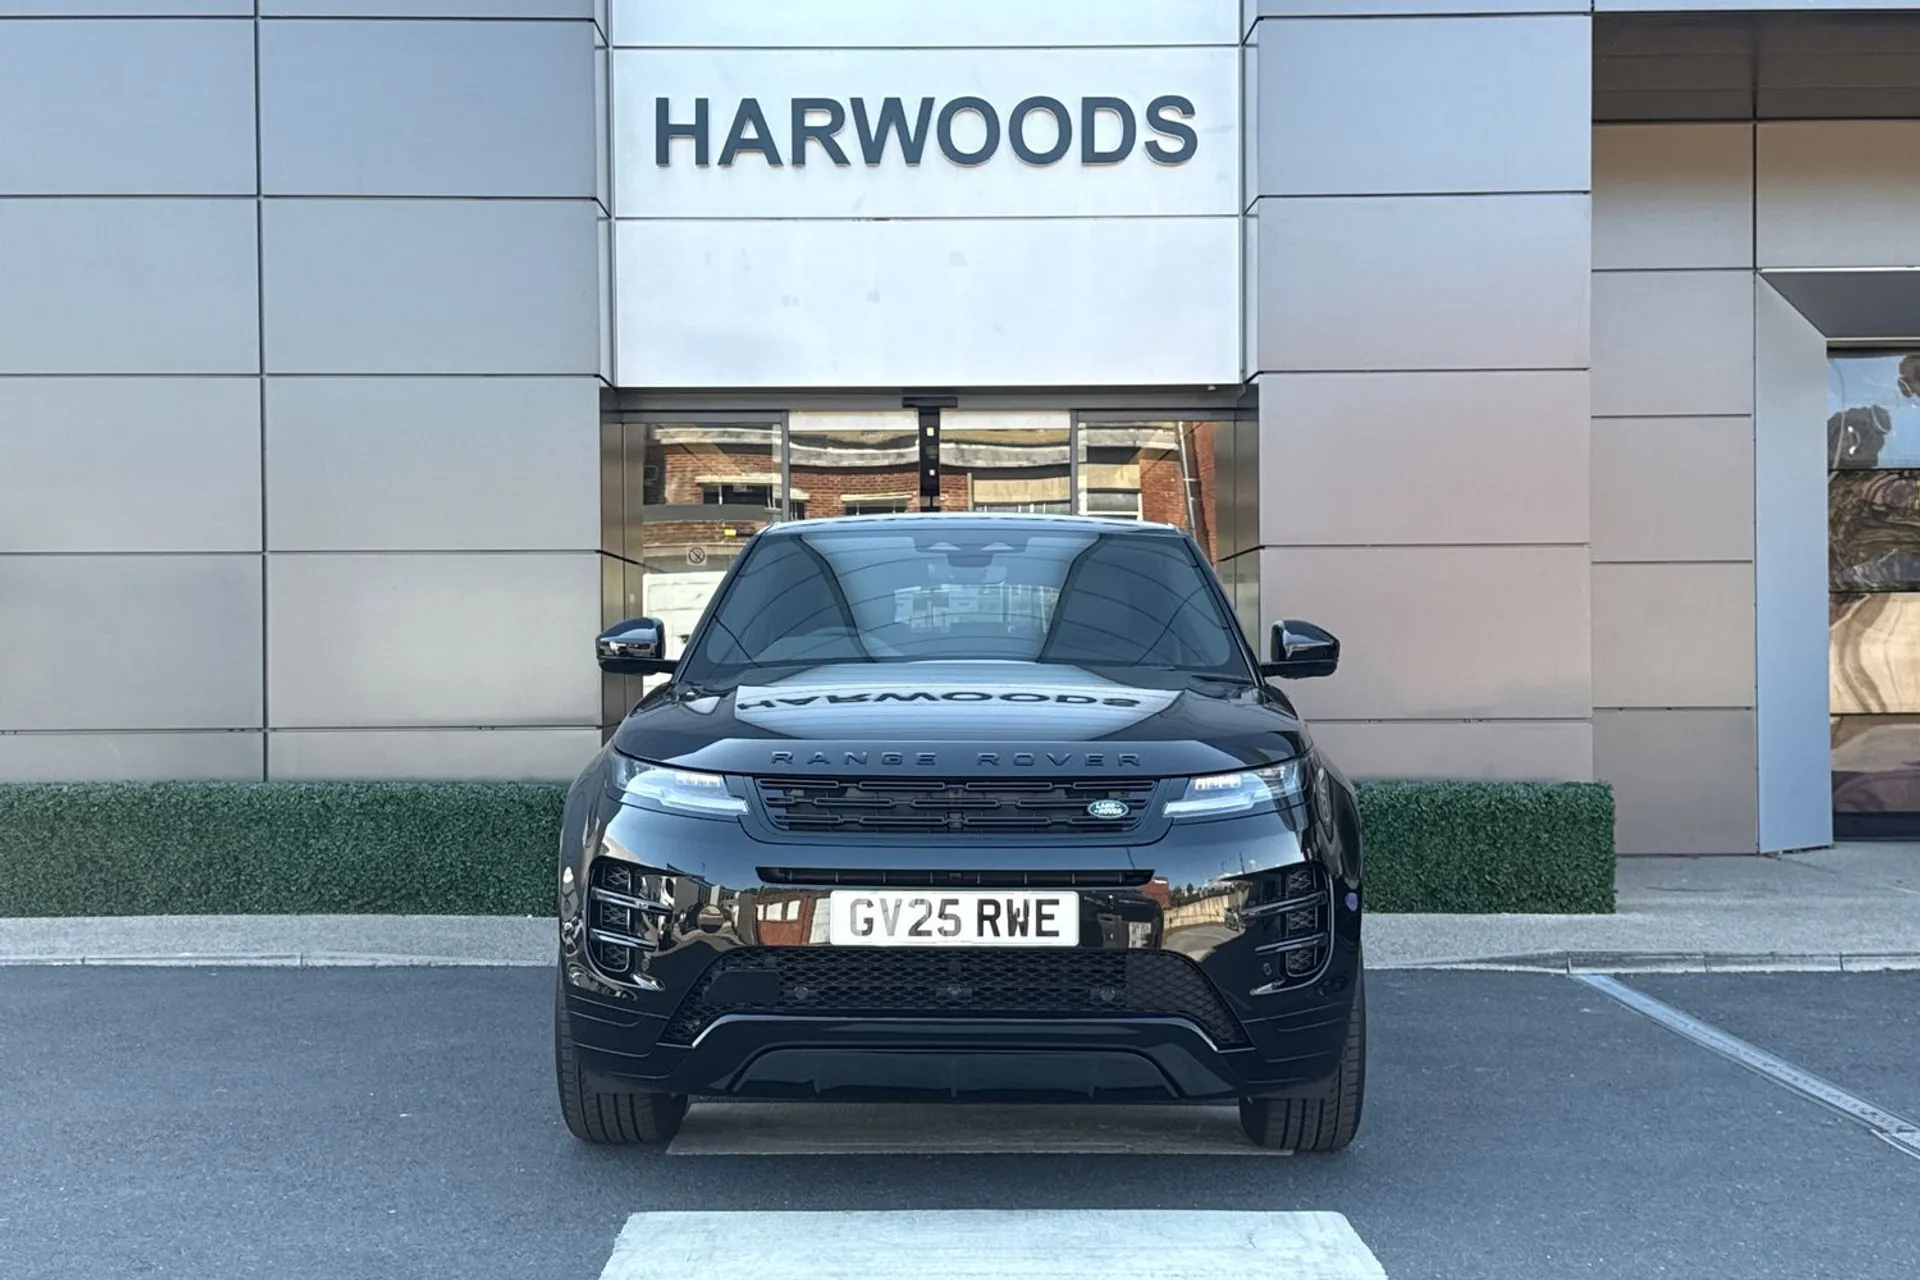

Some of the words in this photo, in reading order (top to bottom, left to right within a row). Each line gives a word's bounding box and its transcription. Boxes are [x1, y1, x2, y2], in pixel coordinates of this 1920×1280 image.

[655, 94, 1199, 167] HARWOODS
[770, 751, 937, 766] RANGE
[976, 752, 1141, 767] ROVER
[850, 898, 962, 937] GV25
[976, 898, 1060, 937] RWE
